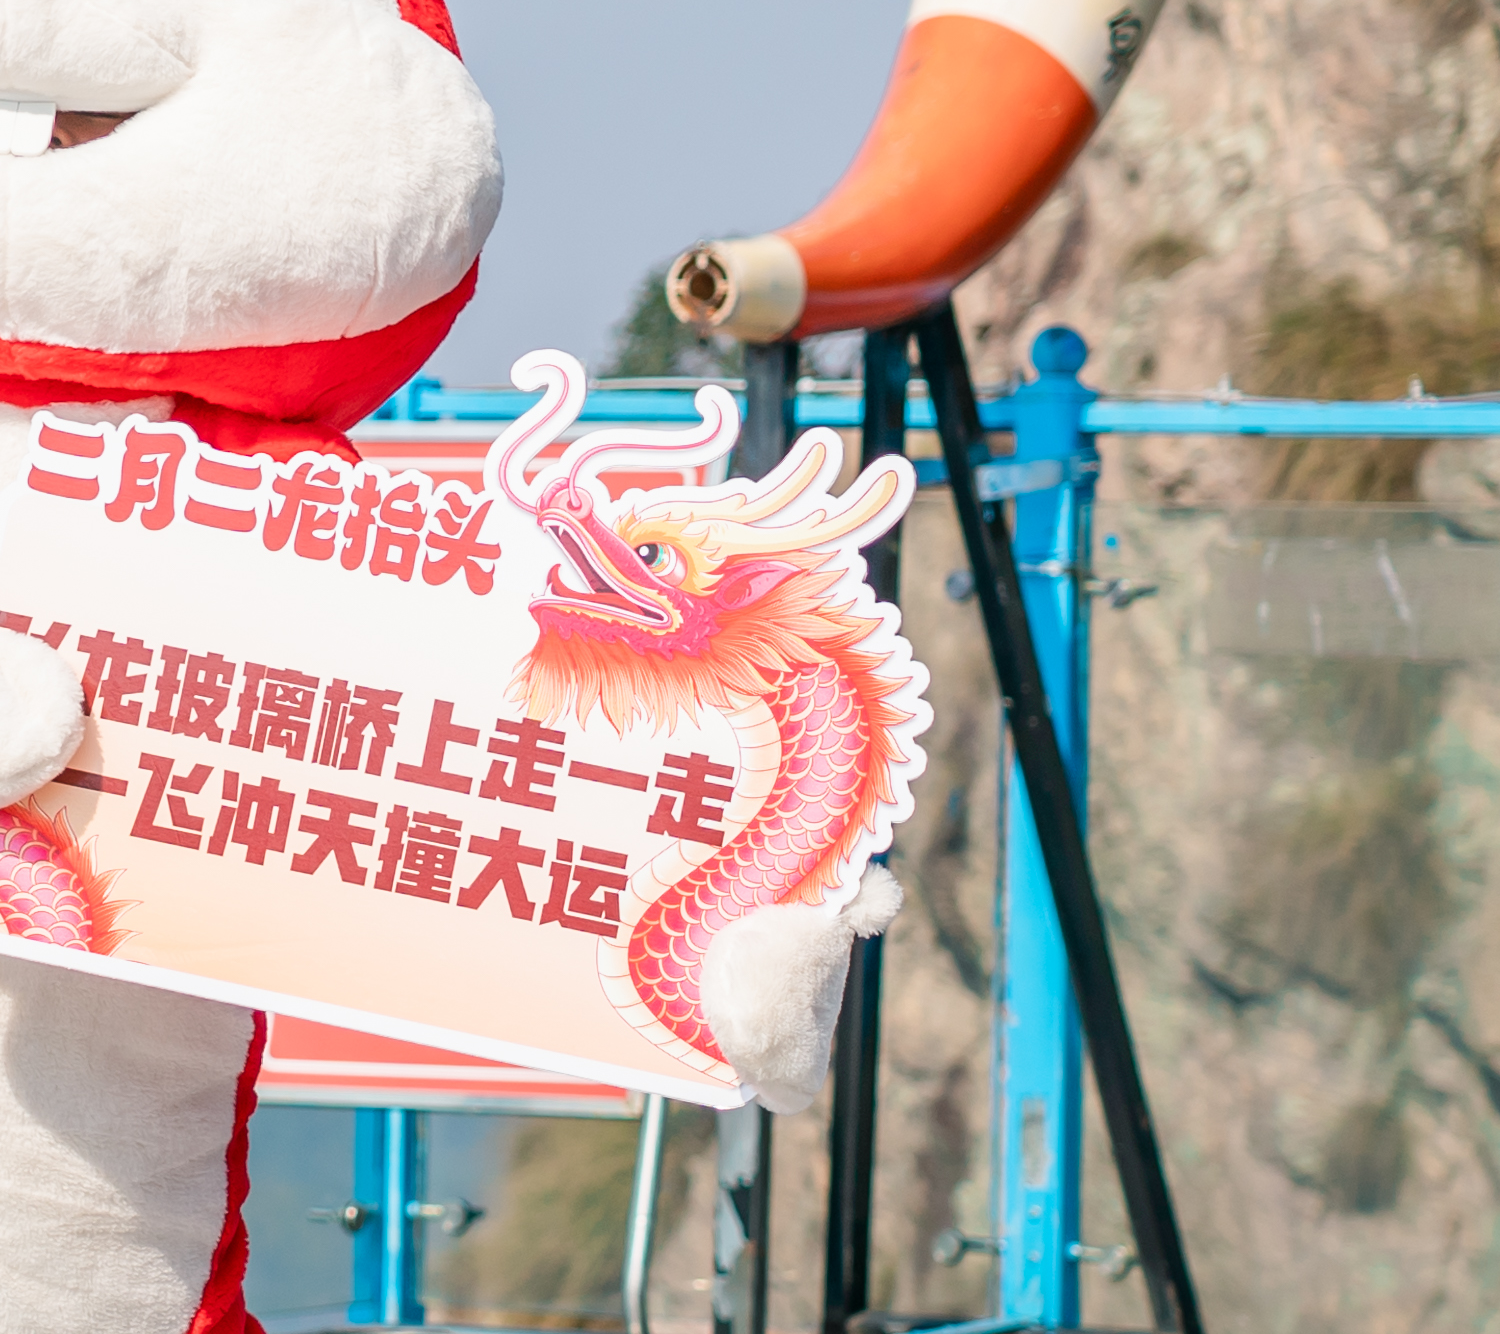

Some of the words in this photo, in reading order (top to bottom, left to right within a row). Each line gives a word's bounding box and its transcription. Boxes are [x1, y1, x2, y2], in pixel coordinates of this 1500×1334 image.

[27, 420, 502, 595] 二月二龙抬头
[51, 752, 629, 939] 一飞冲天撞大运
